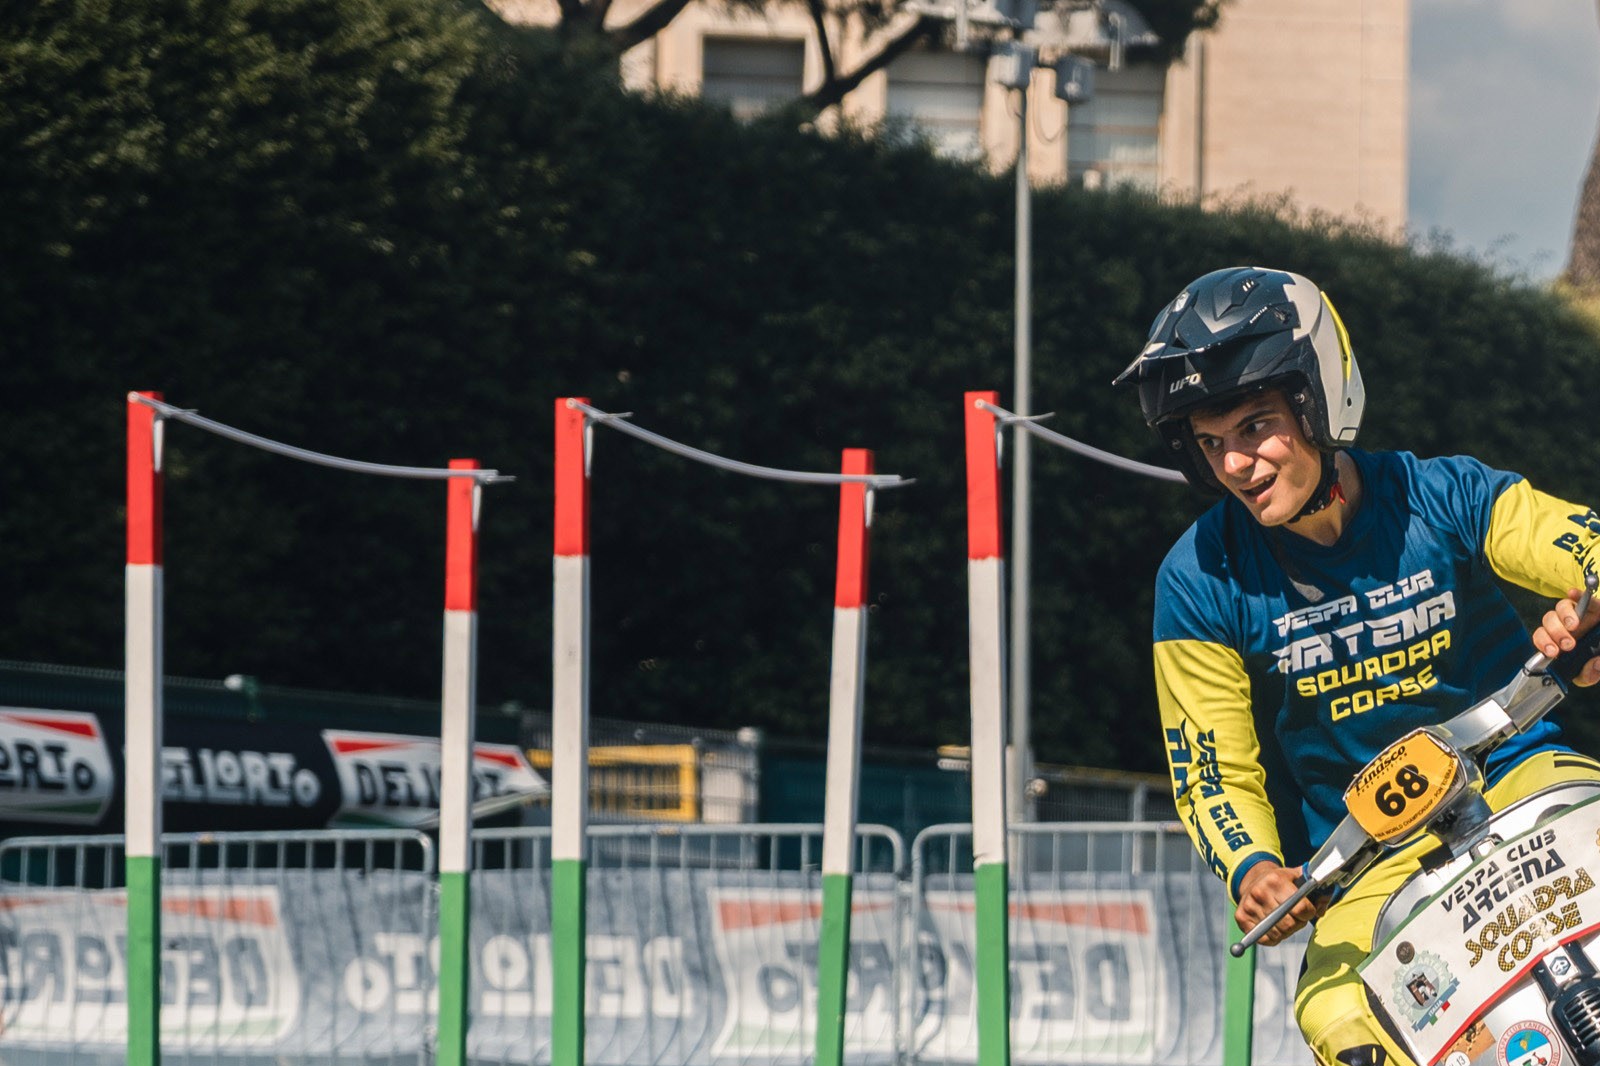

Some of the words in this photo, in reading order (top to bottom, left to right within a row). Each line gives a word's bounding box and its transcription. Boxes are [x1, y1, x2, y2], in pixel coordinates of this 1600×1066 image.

[1169, 373, 1201, 394] UFO
[1271, 590, 1457, 674] ARTENA
[1272, 595, 1358, 637] VESPA
[1364, 569, 1435, 610] CLUB
[1296, 629, 1451, 697] SQUADRA
[1330, 664, 1439, 721] CORSE
[0, 738, 97, 797] RTO
[1375, 764, 1430, 817] 68
[1208, 800, 1254, 852] CLUB
[1441, 861, 1500, 912] VESPA
[1506, 828, 1557, 862] CLUB
[1464, 867, 1596, 968] SQUADRA
[1497, 901, 1583, 973] CORSE
[1428, 1000, 1443, 1017] ITALIA
